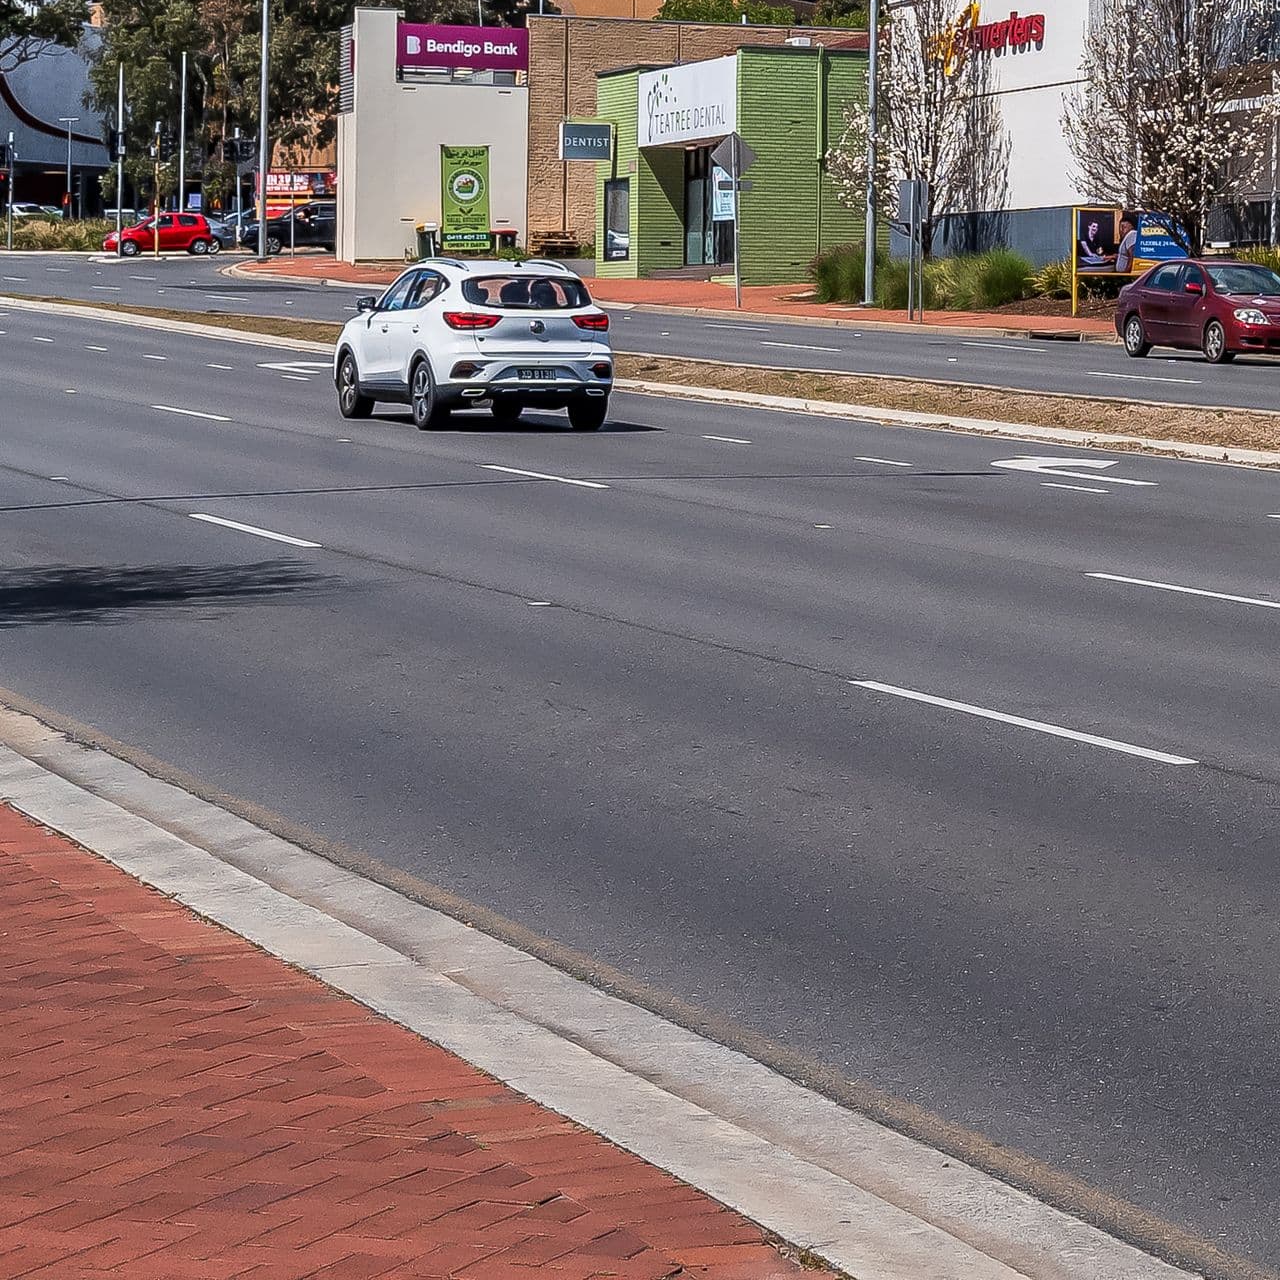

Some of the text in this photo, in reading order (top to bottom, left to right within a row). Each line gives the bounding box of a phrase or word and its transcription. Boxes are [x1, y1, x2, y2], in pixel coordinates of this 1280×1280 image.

[426, 39, 481, 57] Bendigo
[483, 41, 518, 56] Bank
[654, 103, 726, 134] TEATREE DENTAL
[564, 136, 610, 148] DENTIST
